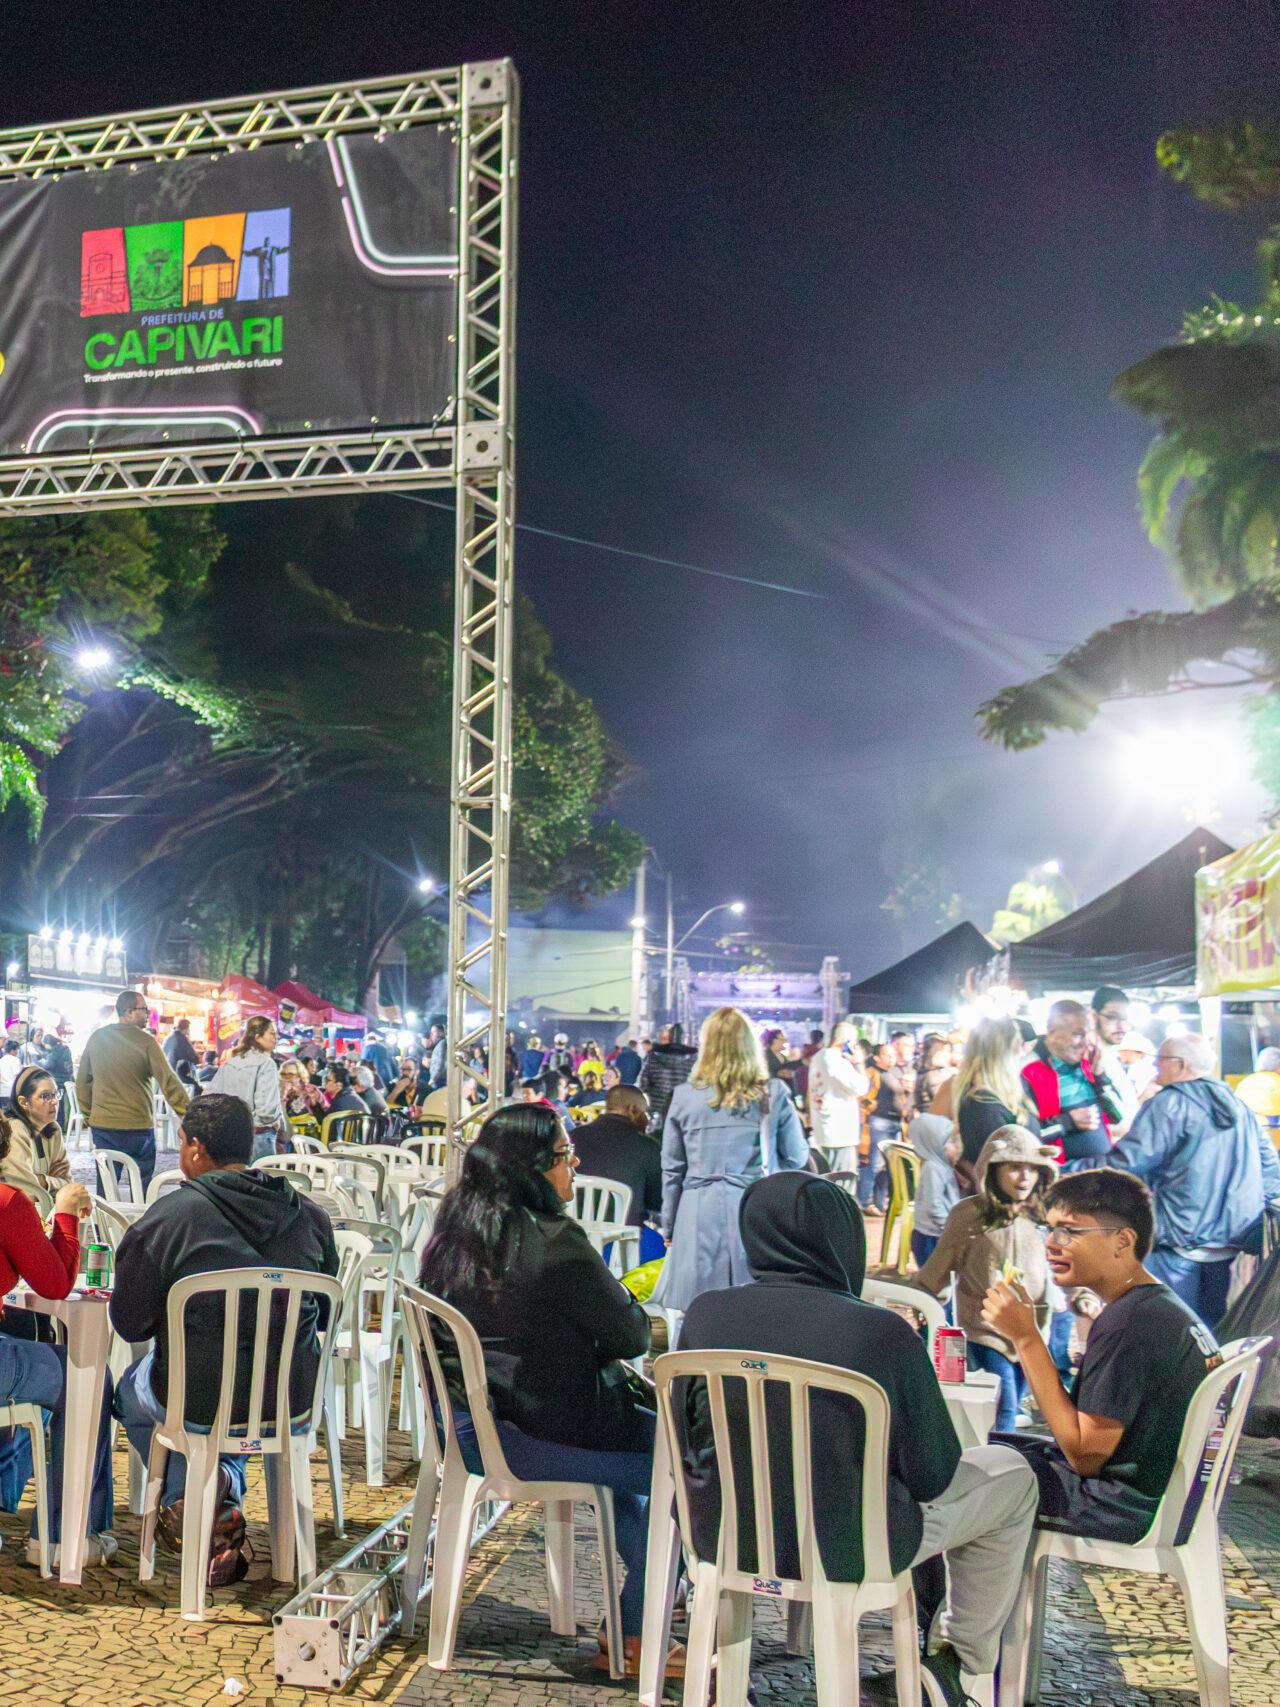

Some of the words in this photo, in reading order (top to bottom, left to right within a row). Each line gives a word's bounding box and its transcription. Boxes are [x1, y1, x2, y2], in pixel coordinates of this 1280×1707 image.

[141, 310, 206, 326] PREFEITURA
[209, 308, 224, 320] DE
[84, 315, 284, 370] CAPIVARI
